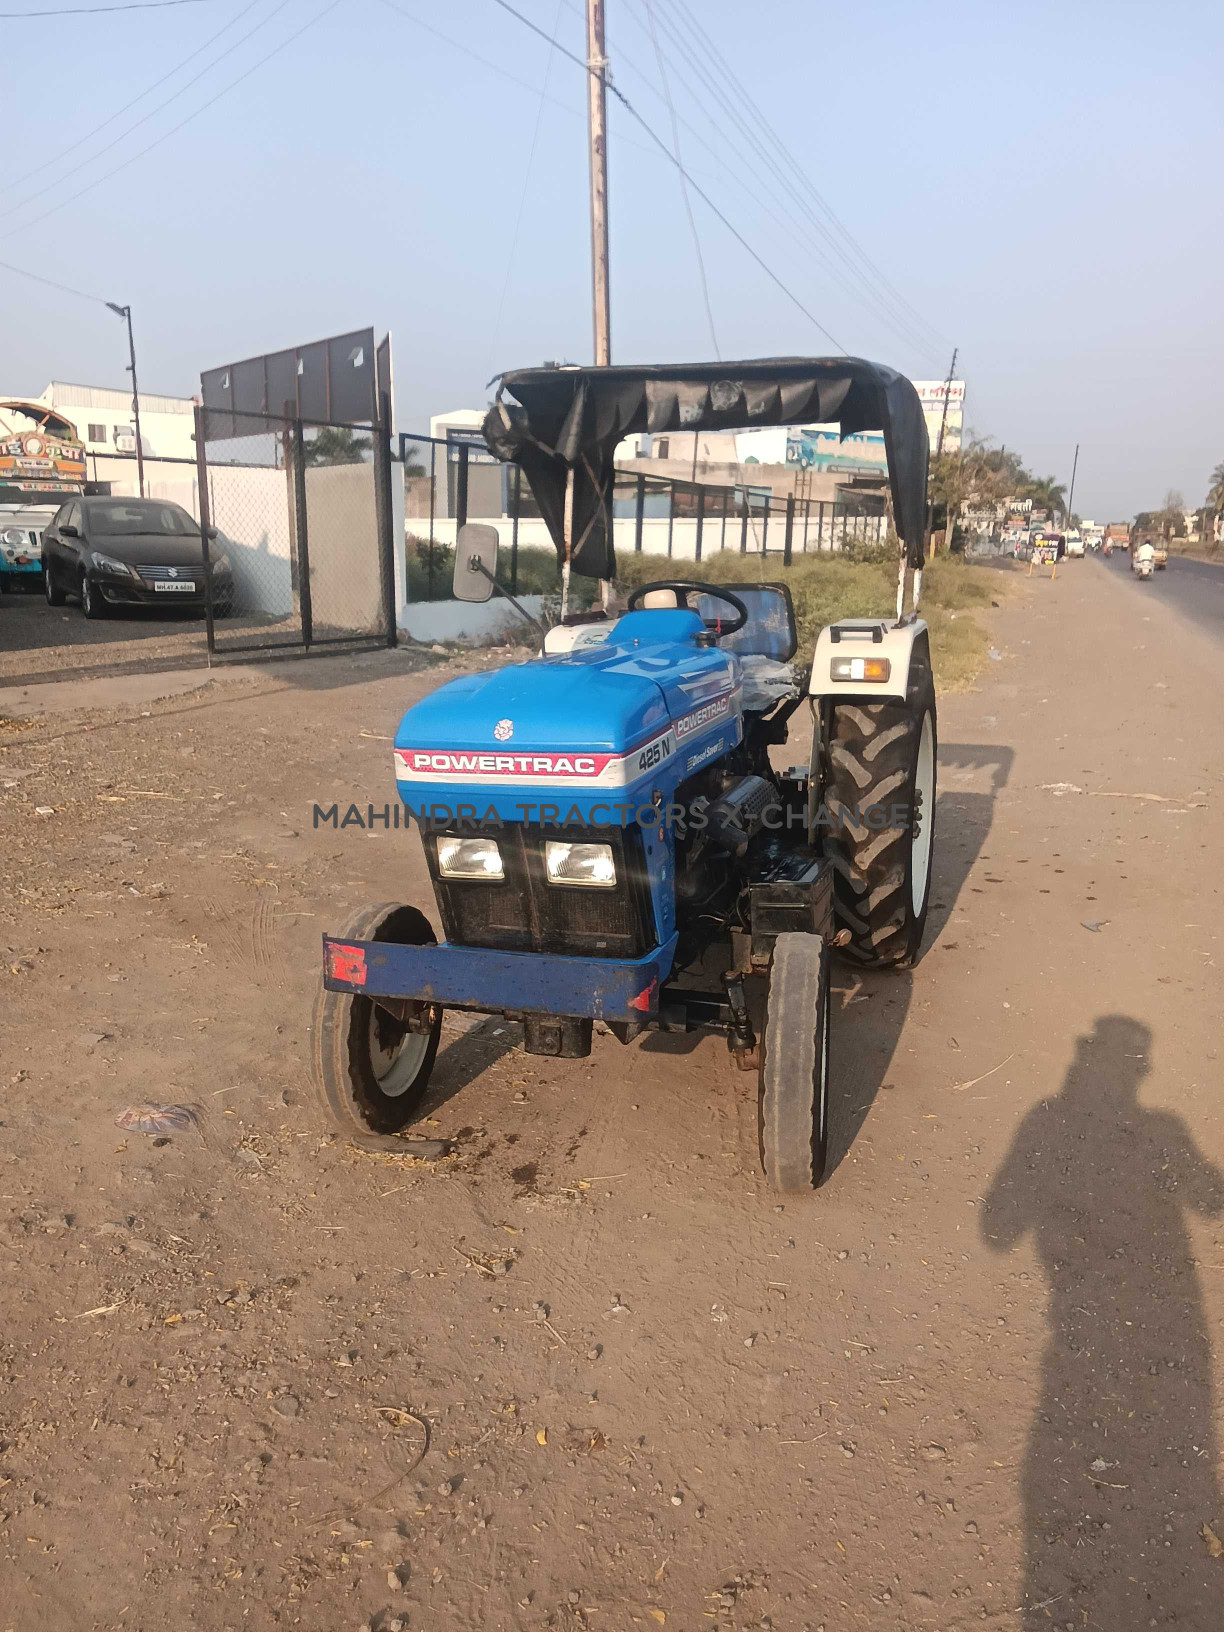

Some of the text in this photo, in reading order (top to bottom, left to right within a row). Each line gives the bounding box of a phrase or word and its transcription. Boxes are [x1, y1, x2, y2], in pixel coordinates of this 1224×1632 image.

[677, 698, 727, 734] POWERTRAC
[413, 754, 596, 774] POWERTRAC
[639, 737, 671, 769] 425 N
[692, 744, 719, 767] Diesel Saver
